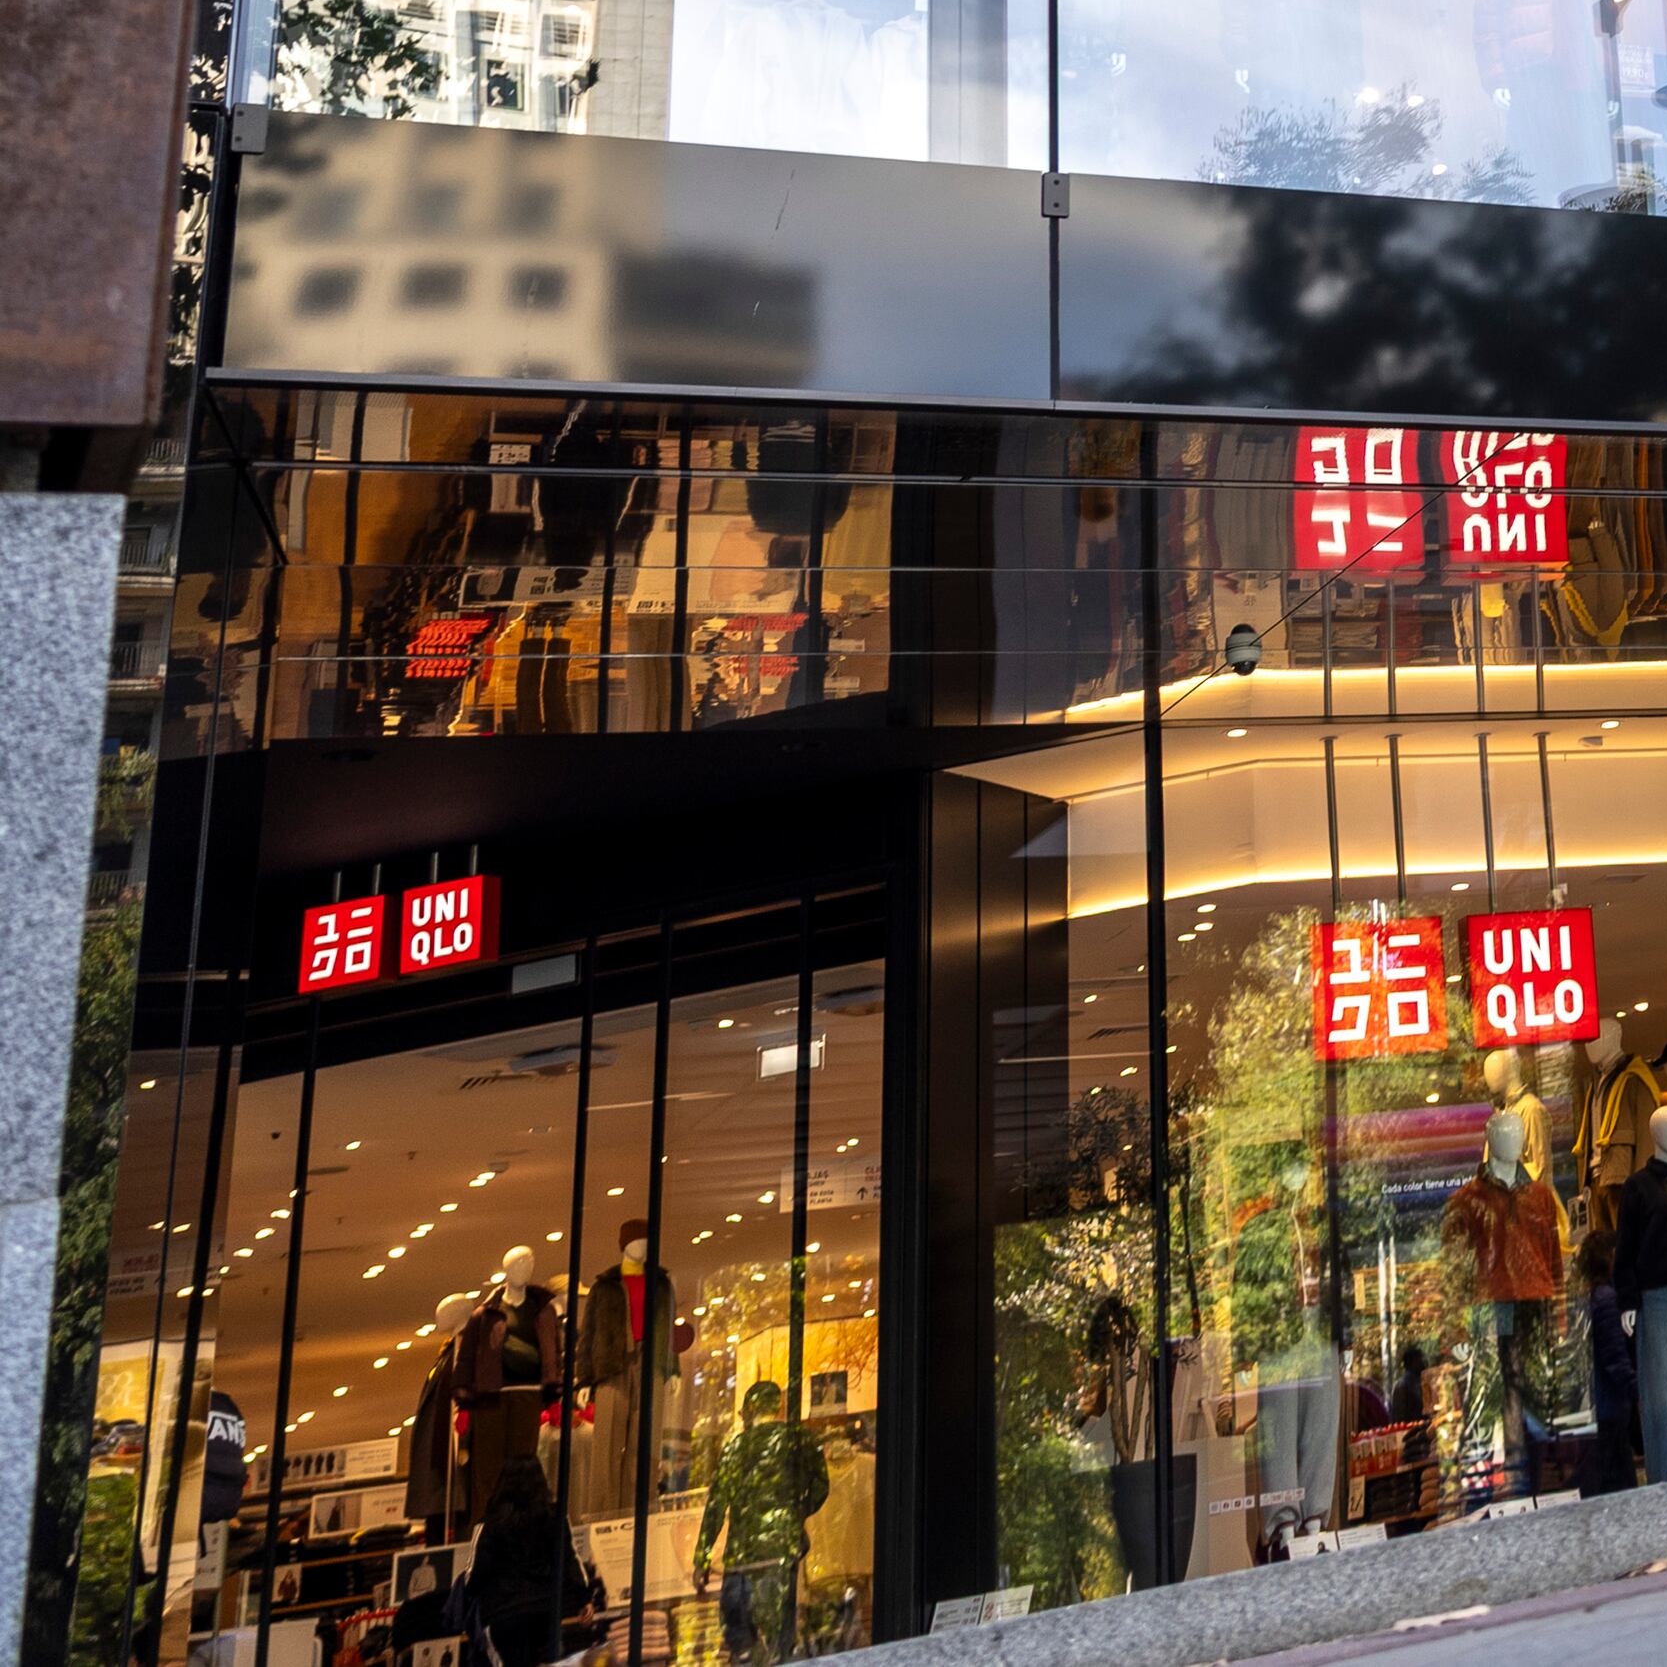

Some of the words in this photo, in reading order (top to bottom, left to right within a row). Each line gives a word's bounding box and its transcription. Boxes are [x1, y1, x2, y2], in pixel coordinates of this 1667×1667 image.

[314, 906, 373, 946] ユニ
[412, 888, 469, 927] UNI
[410, 922, 473, 965] QLO
[1329, 934, 1427, 985] ユニ
[1483, 925, 1572, 975] UNI
[1486, 979, 1584, 1037] QLO
